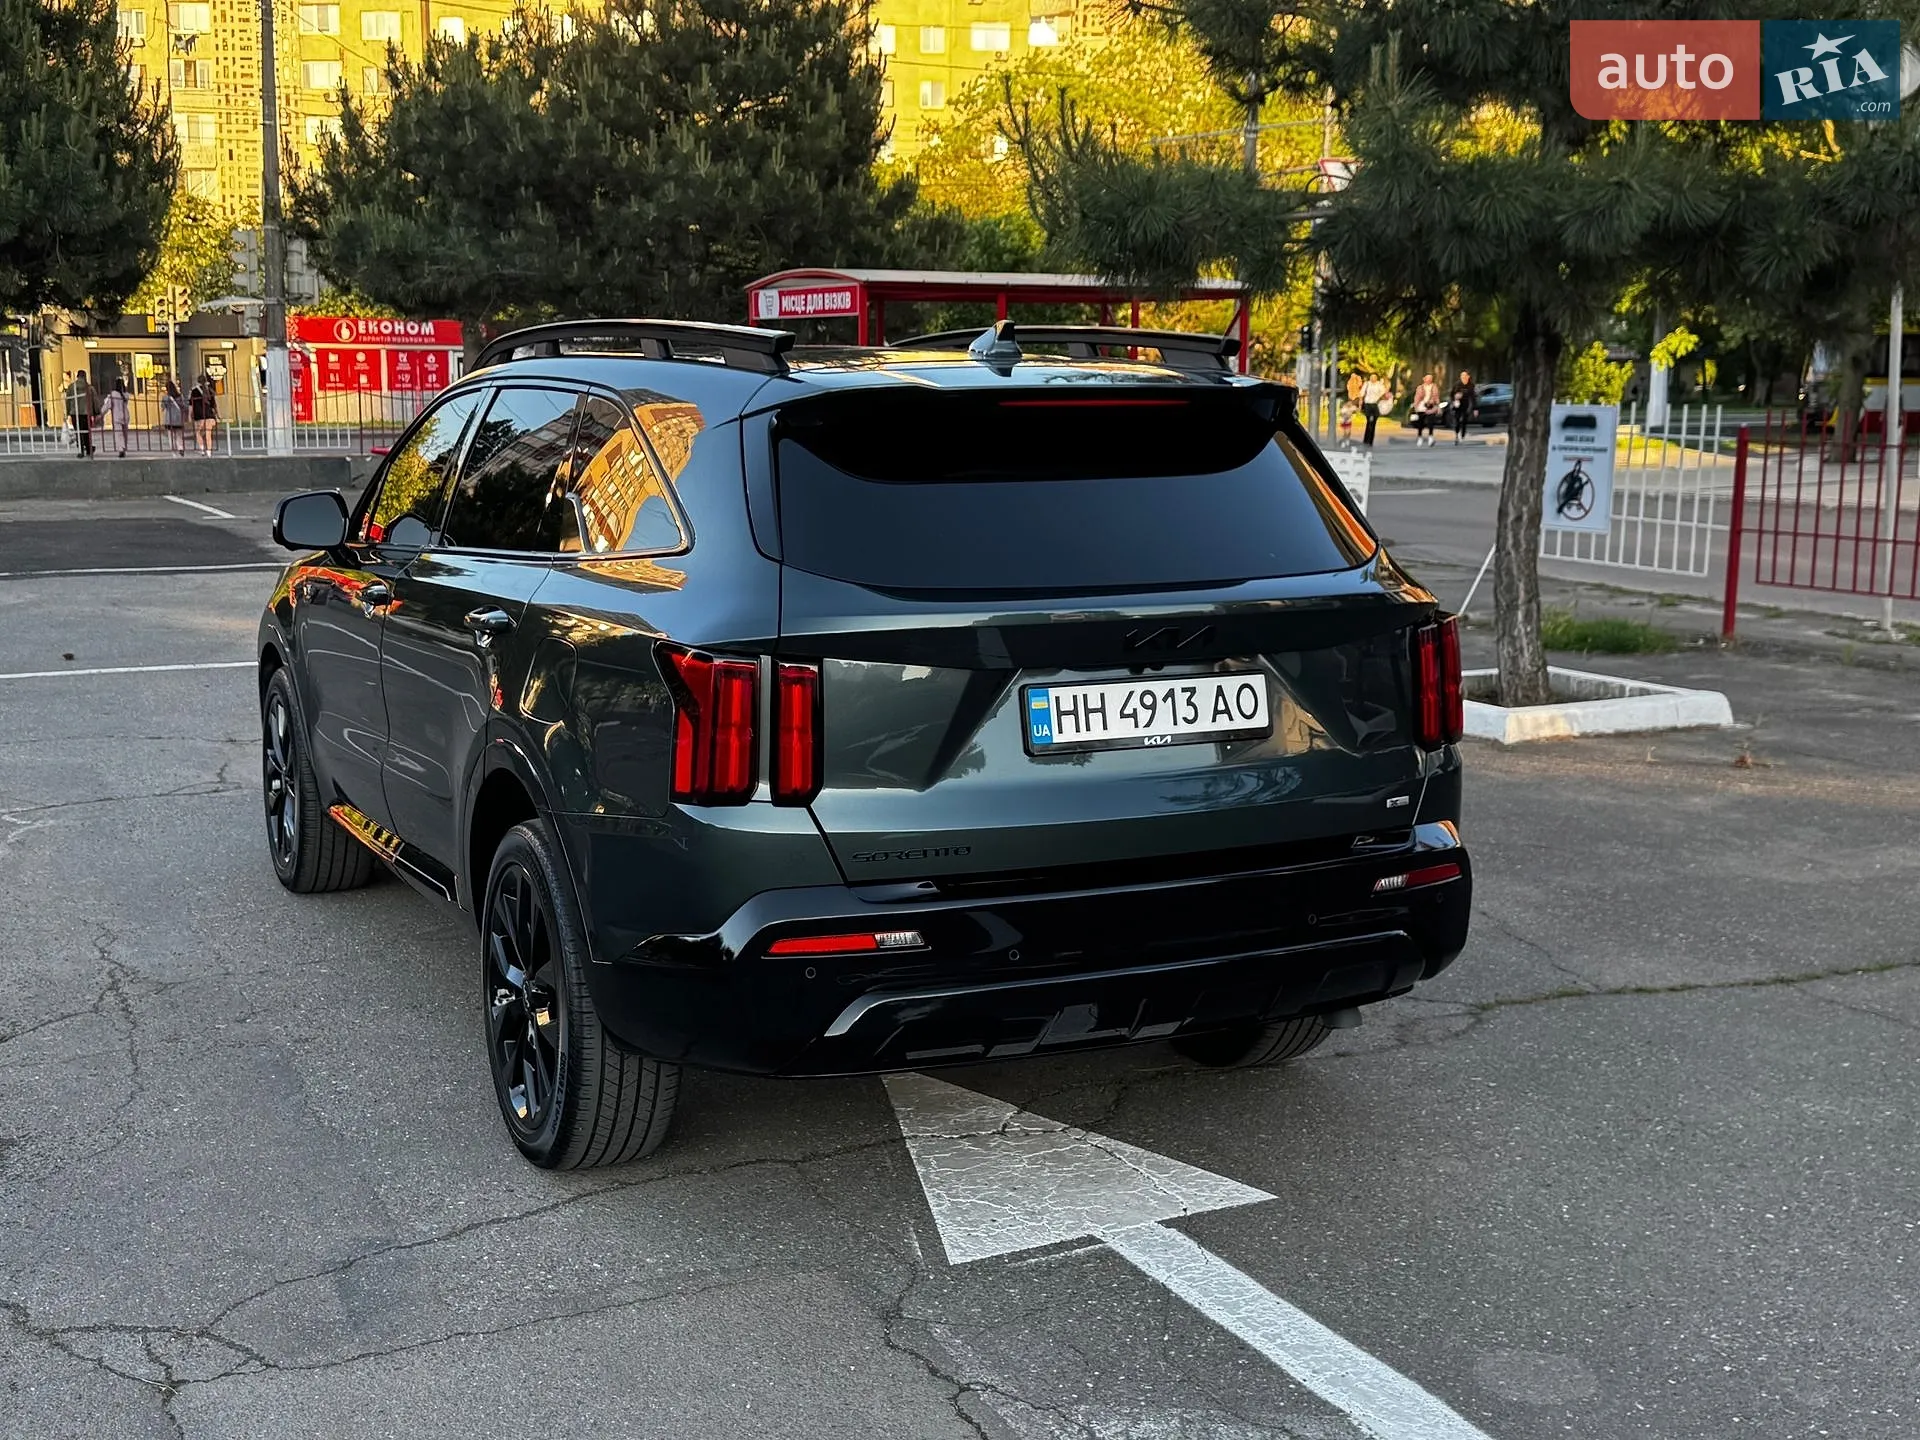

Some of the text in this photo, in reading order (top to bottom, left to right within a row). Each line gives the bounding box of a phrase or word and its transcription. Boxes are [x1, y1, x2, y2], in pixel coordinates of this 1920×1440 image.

[781, 291, 851, 314] МІСЦЕ ДЛЯ ВІЗКІВ
[358, 320, 435, 336] ЕКОНОМ
[1119, 686, 1199, 729] 4913
[1033, 724, 1051, 738] UA
[1143, 734, 1172, 746] KIA
[849, 845, 971, 863] SORENTO
